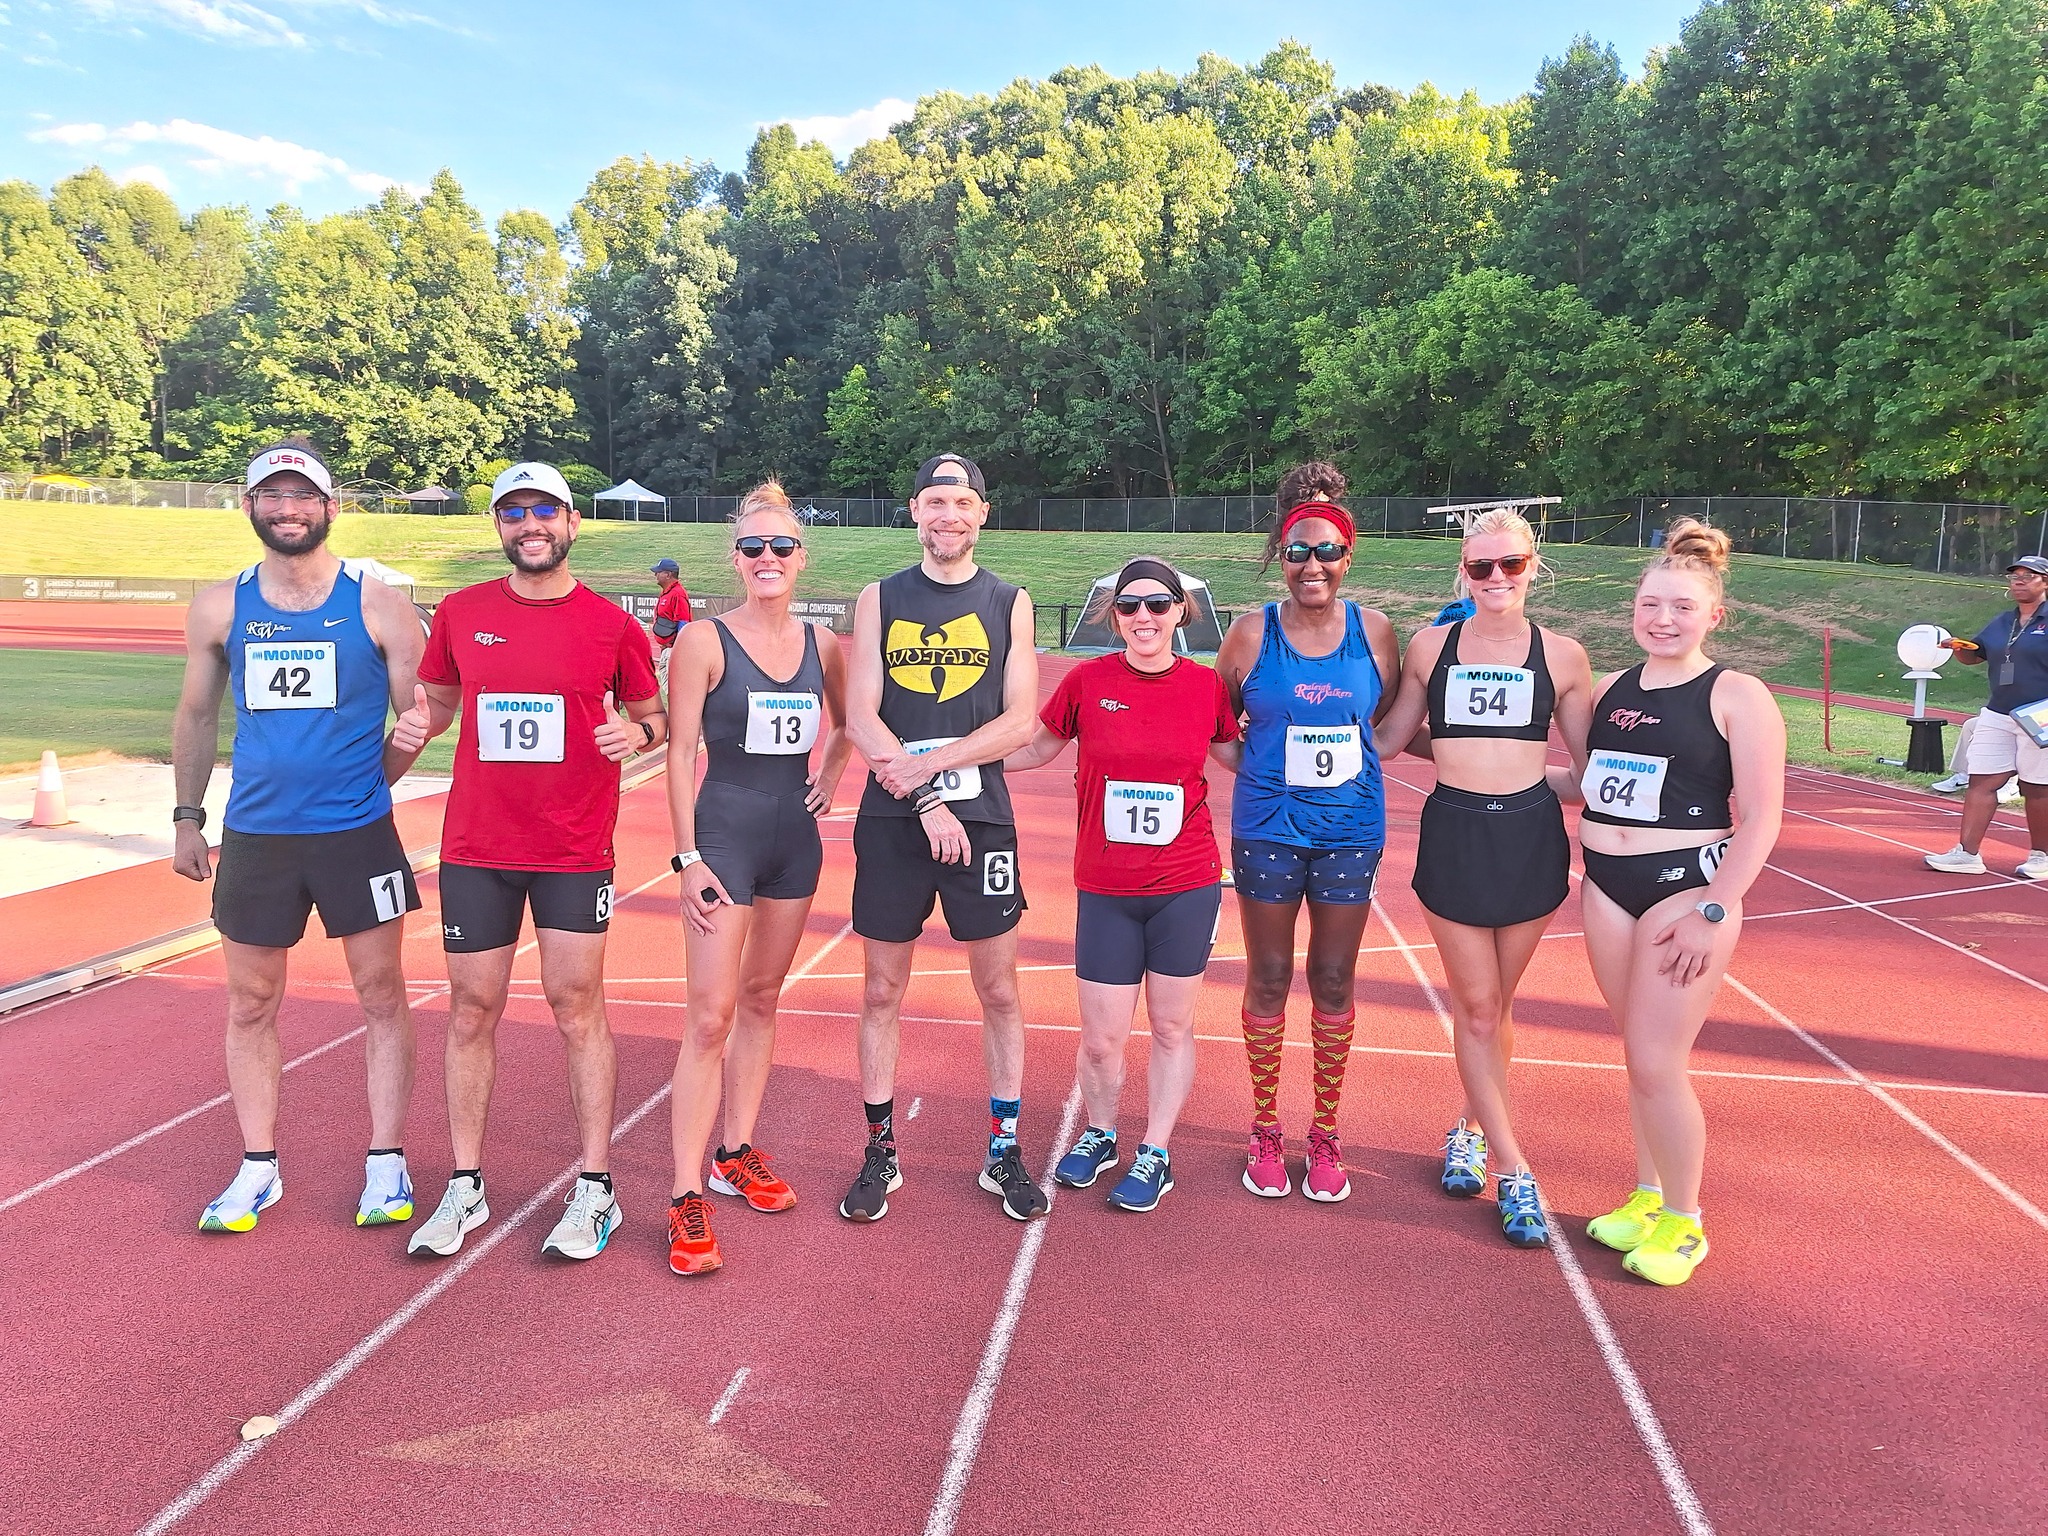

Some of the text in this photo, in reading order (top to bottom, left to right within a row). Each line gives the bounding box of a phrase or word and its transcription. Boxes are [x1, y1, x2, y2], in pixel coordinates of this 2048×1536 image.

[269, 455, 305, 468] USA
[23, 578, 38, 598] 3
[637, 597, 659, 606] OUTDO
[787, 603, 847, 615] NDOOR CONFERENCE
[264, 649, 325, 661] MONDO
[886, 648, 990, 667] WU-TANG
[268, 667, 312, 698] 42
[1466, 671, 1524, 683] MONDO
[495, 701, 554, 713] MONDO
[766, 699, 813, 710] MONDO
[1468, 687, 1508, 717] 54
[499, 718, 539, 750] 19
[770, 715, 802, 745] 13
[1303, 733, 1352, 745] MONDO
[1315, 749, 1334, 778] 9
[1605, 758, 1657, 775] MONDO
[1122, 788, 1175, 802] MONDO
[1599, 775, 1638, 808] 64
[1486, 800, 1504, 811] alo
[1126, 805, 1161, 836] 15
[987, 854, 1010, 892] 6
[381, 876, 400, 915] 1
[598, 887, 609, 919] 3
